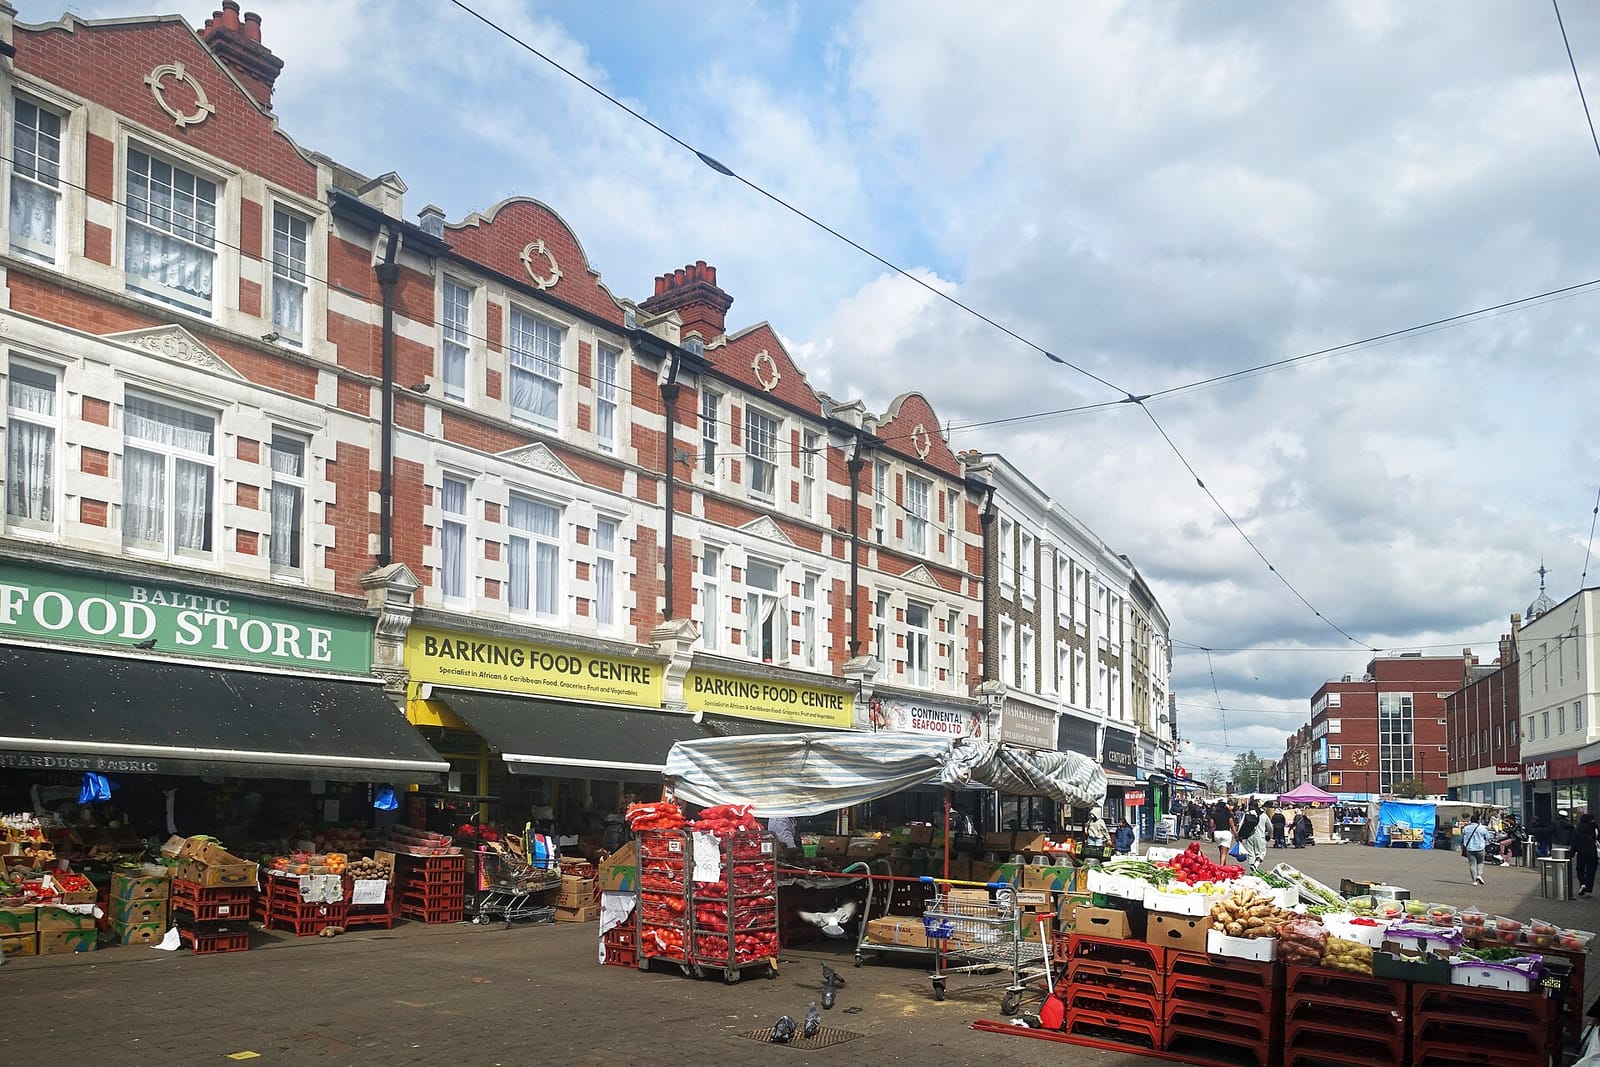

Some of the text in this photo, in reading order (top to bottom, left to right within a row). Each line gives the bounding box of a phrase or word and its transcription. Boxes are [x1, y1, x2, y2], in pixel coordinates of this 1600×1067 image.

[131, 586, 230, 614] BALTIC
[0, 584, 332, 662] FOOD STORE
[425, 635, 650, 685] BARKING FOOD CENTRE
[439, 666, 471, 676] Specialist
[471, 669, 477, 677] in
[479, 671, 502, 680] African
[509, 675, 542, 685] Caribbean
[587, 684, 600, 692] Fruit
[611, 687, 638, 697] Vegetables
[694, 675, 843, 710] BARKING FOOD CENTRE
[911, 707, 963, 724] CONTINENTAL
[1005, 702, 1034, 721] BARKING
[912, 718, 962, 734] SEAFOOD LTD
[97, 757, 158, 772] FABRIC
[1525, 760, 1547, 781] Iceland
